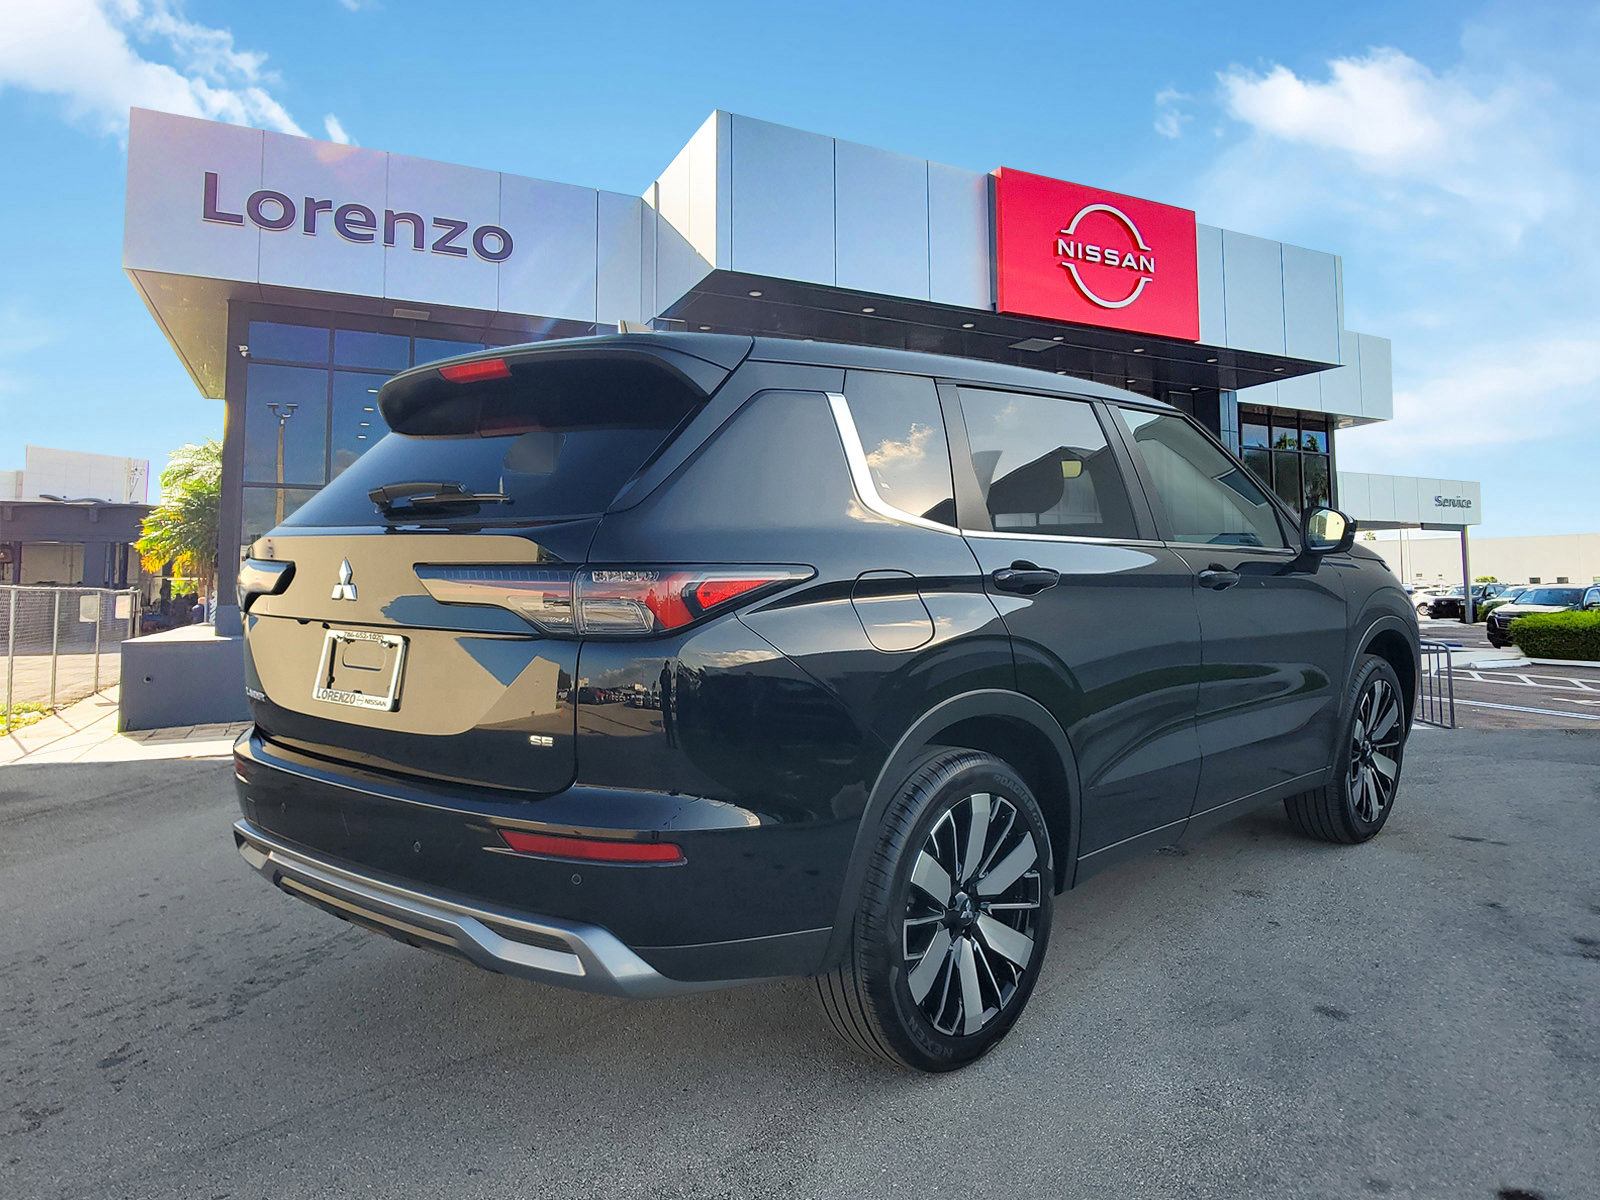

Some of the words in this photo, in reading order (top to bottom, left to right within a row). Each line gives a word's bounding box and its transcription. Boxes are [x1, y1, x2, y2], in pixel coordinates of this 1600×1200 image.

[202, 171, 514, 262] Lorenzo
[1057, 238, 1155, 273] NISSAN
[1434, 495, 1472, 508] Service
[316, 688, 356, 704] LORENZO
[364, 698, 387, 707] NISSAN
[529, 735, 553, 747] SE
